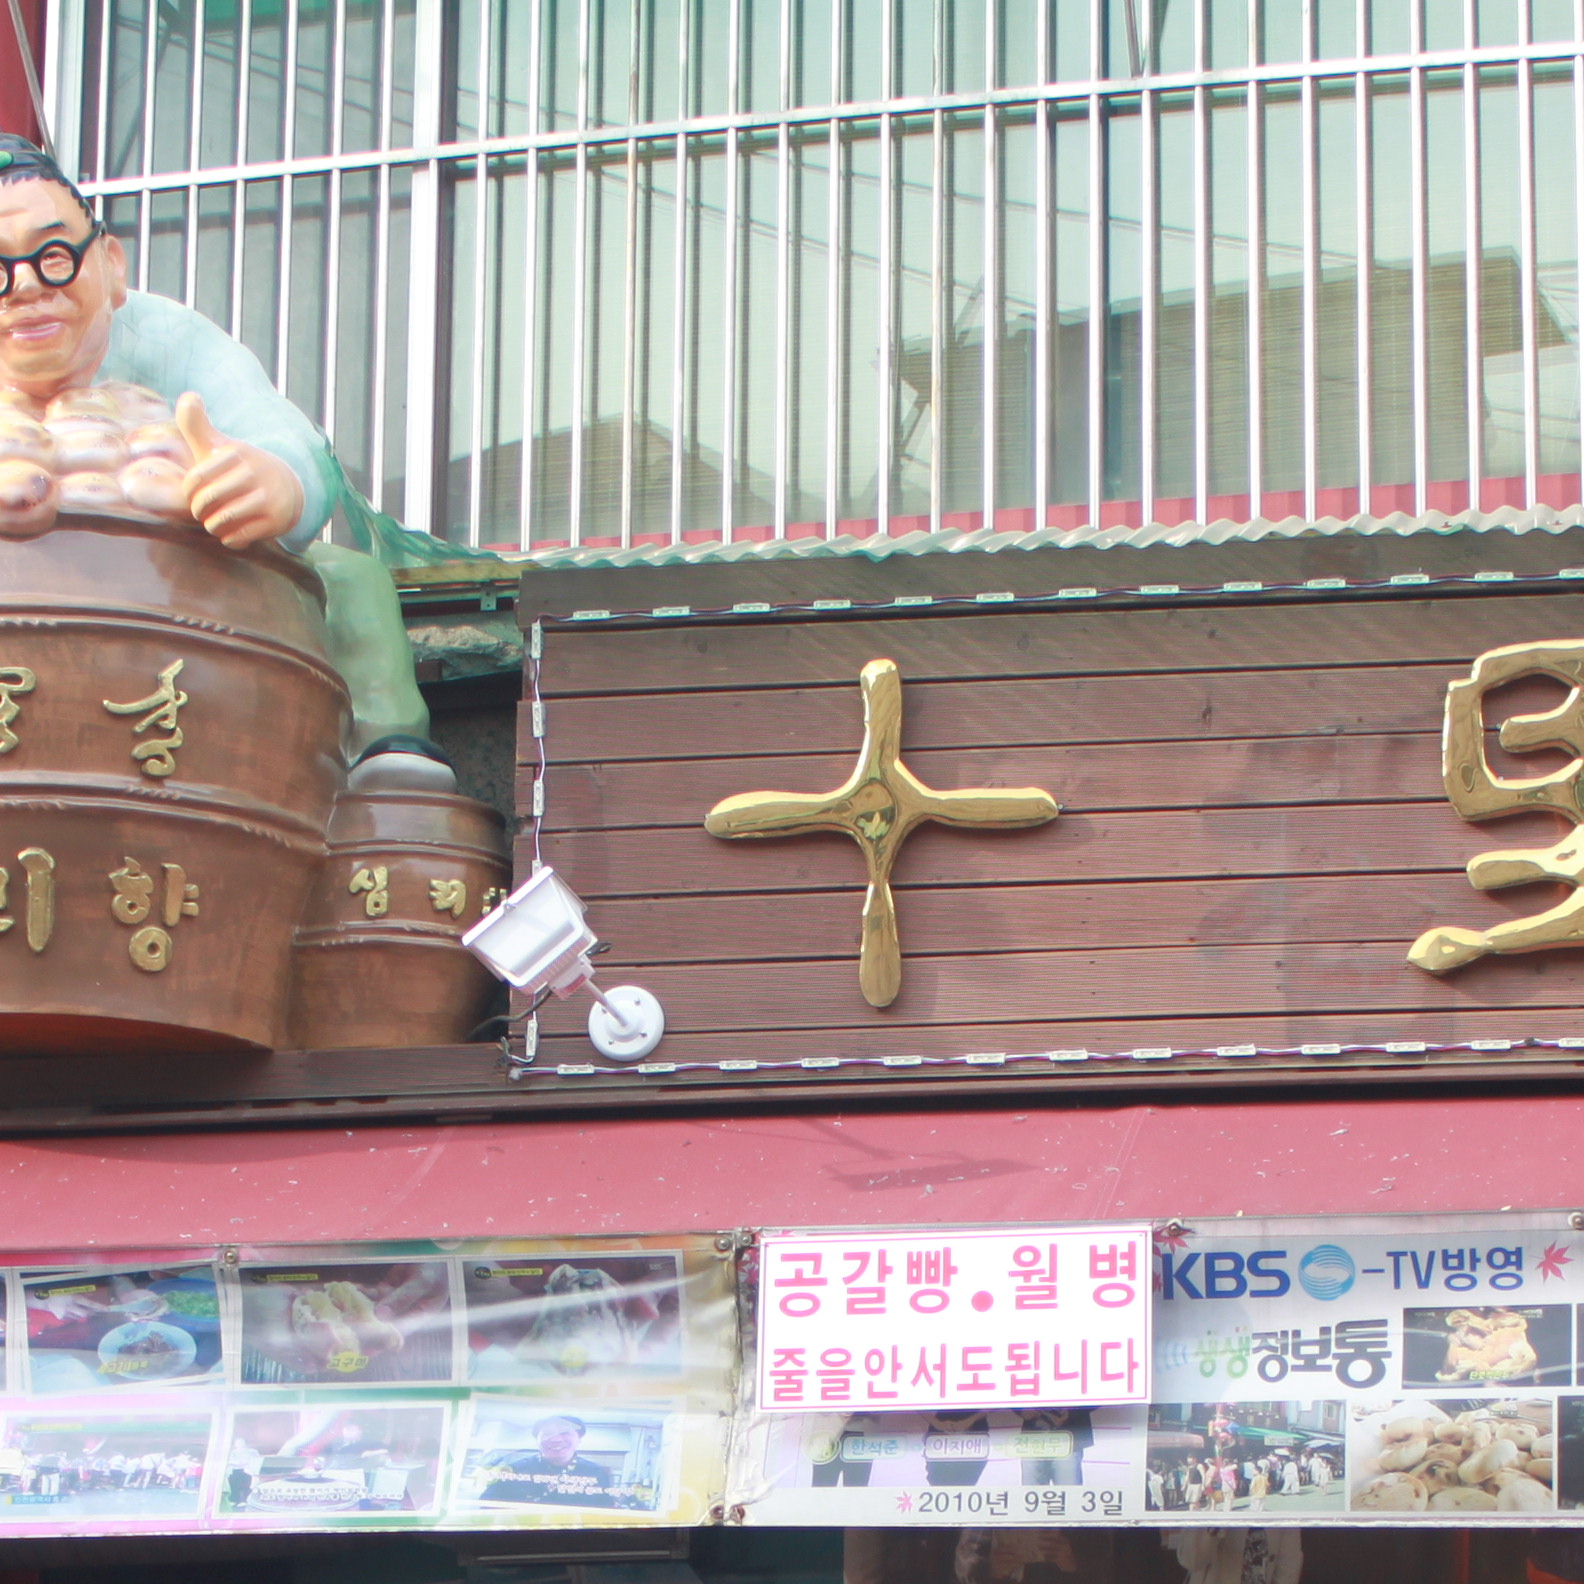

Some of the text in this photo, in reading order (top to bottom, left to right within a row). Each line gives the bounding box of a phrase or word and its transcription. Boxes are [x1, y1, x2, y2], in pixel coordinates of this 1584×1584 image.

[1161, 1250, 1291, 1300] KBS
[1194, 1318, 1393, 1389] 생생정보통
[932, 1436, 983, 1455] 이지애
[919, 1490, 1124, 1515] 2010년 9월 3일
